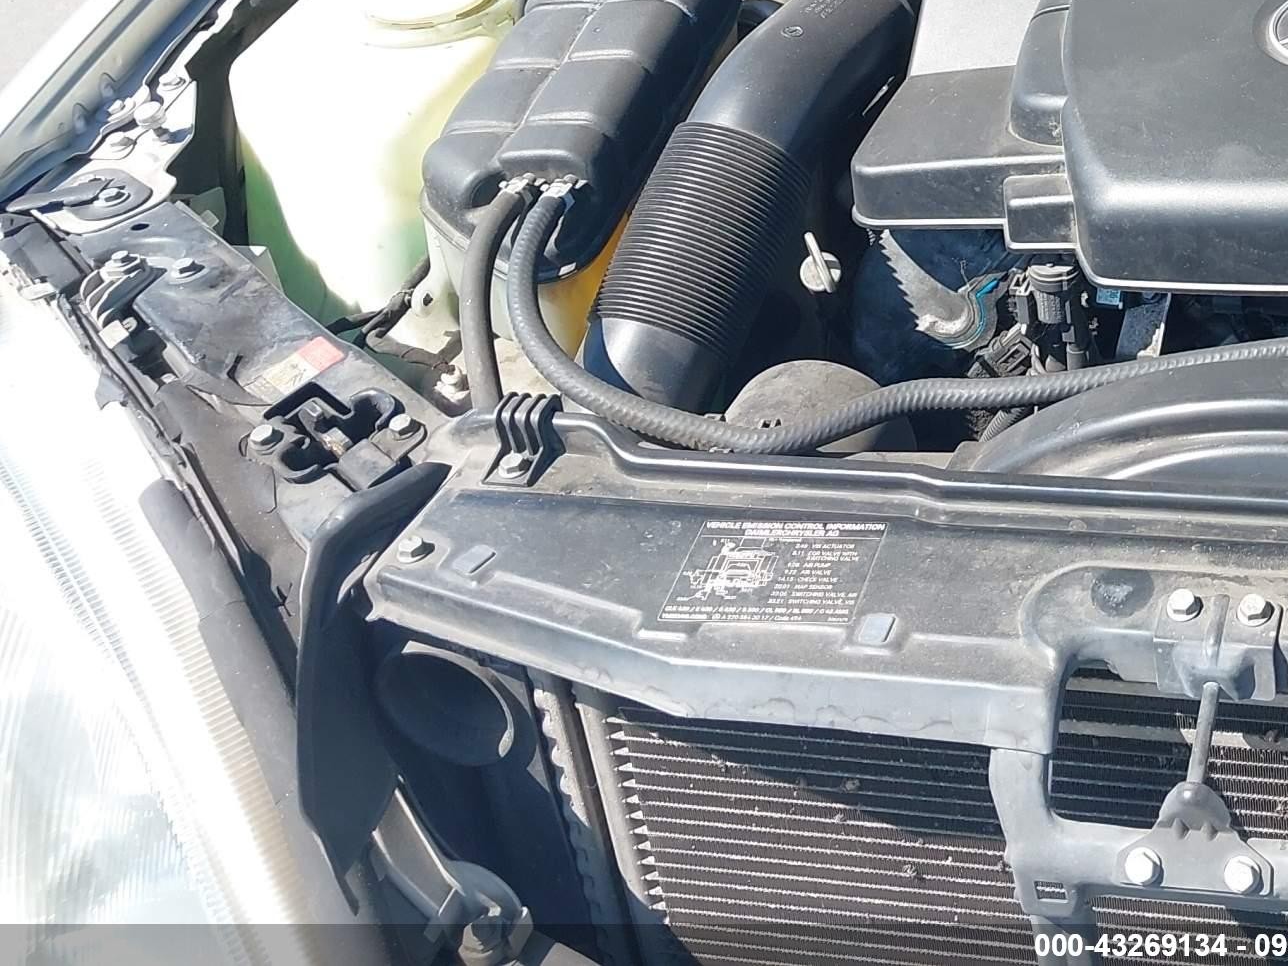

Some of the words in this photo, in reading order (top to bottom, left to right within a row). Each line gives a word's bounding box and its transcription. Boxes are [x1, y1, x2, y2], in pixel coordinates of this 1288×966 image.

[707, 521, 741, 529] VEHICLE
[784, 522, 824, 530] CONTROL
[826, 523, 886, 531] INFORMATION
